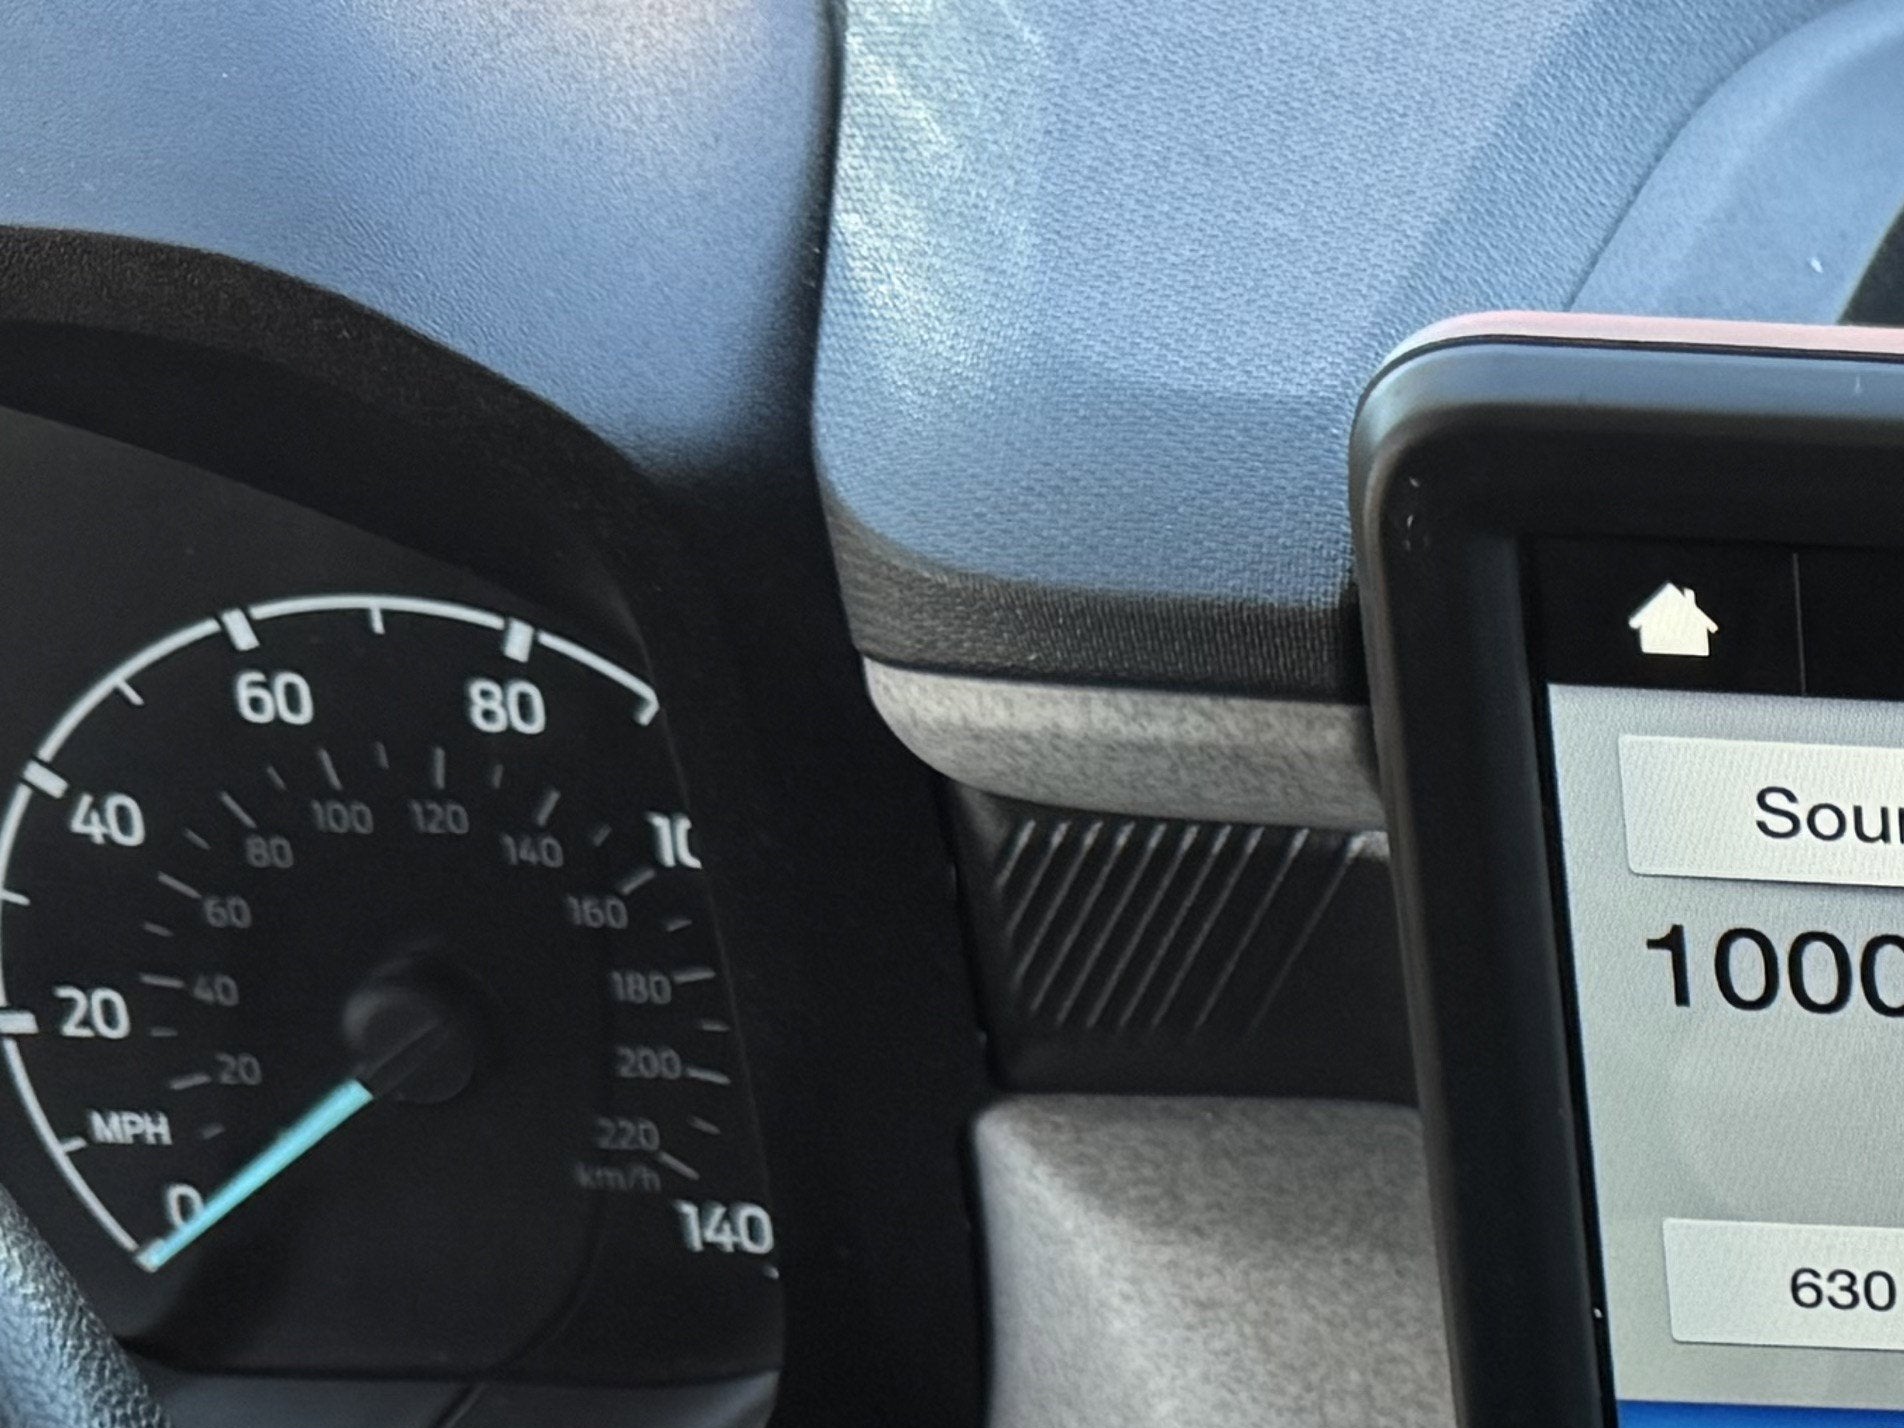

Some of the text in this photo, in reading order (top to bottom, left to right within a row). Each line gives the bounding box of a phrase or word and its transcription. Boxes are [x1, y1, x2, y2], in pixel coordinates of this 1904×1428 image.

[235, 671, 314, 725] 60
[468, 679, 546, 735] 80
[70, 793, 145, 847] 40
[311, 799, 374, 835] 100
[410, 800, 470, 835] 120
[245, 834, 294, 869] 80
[502, 834, 564, 868] 140
[202, 896, 252, 929] 60
[567, 895, 629, 929] 160
[192, 974, 239, 1007] 40
[611, 971, 672, 1005] 180
[55, 986, 130, 1039] 20
[215, 1052, 262, 1086] 20
[618, 1046, 683, 1080] 200
[90, 1111, 172, 1145] MPH
[678, 1201, 774, 1254] 140
[1790, 1267, 1897, 1312] 630
